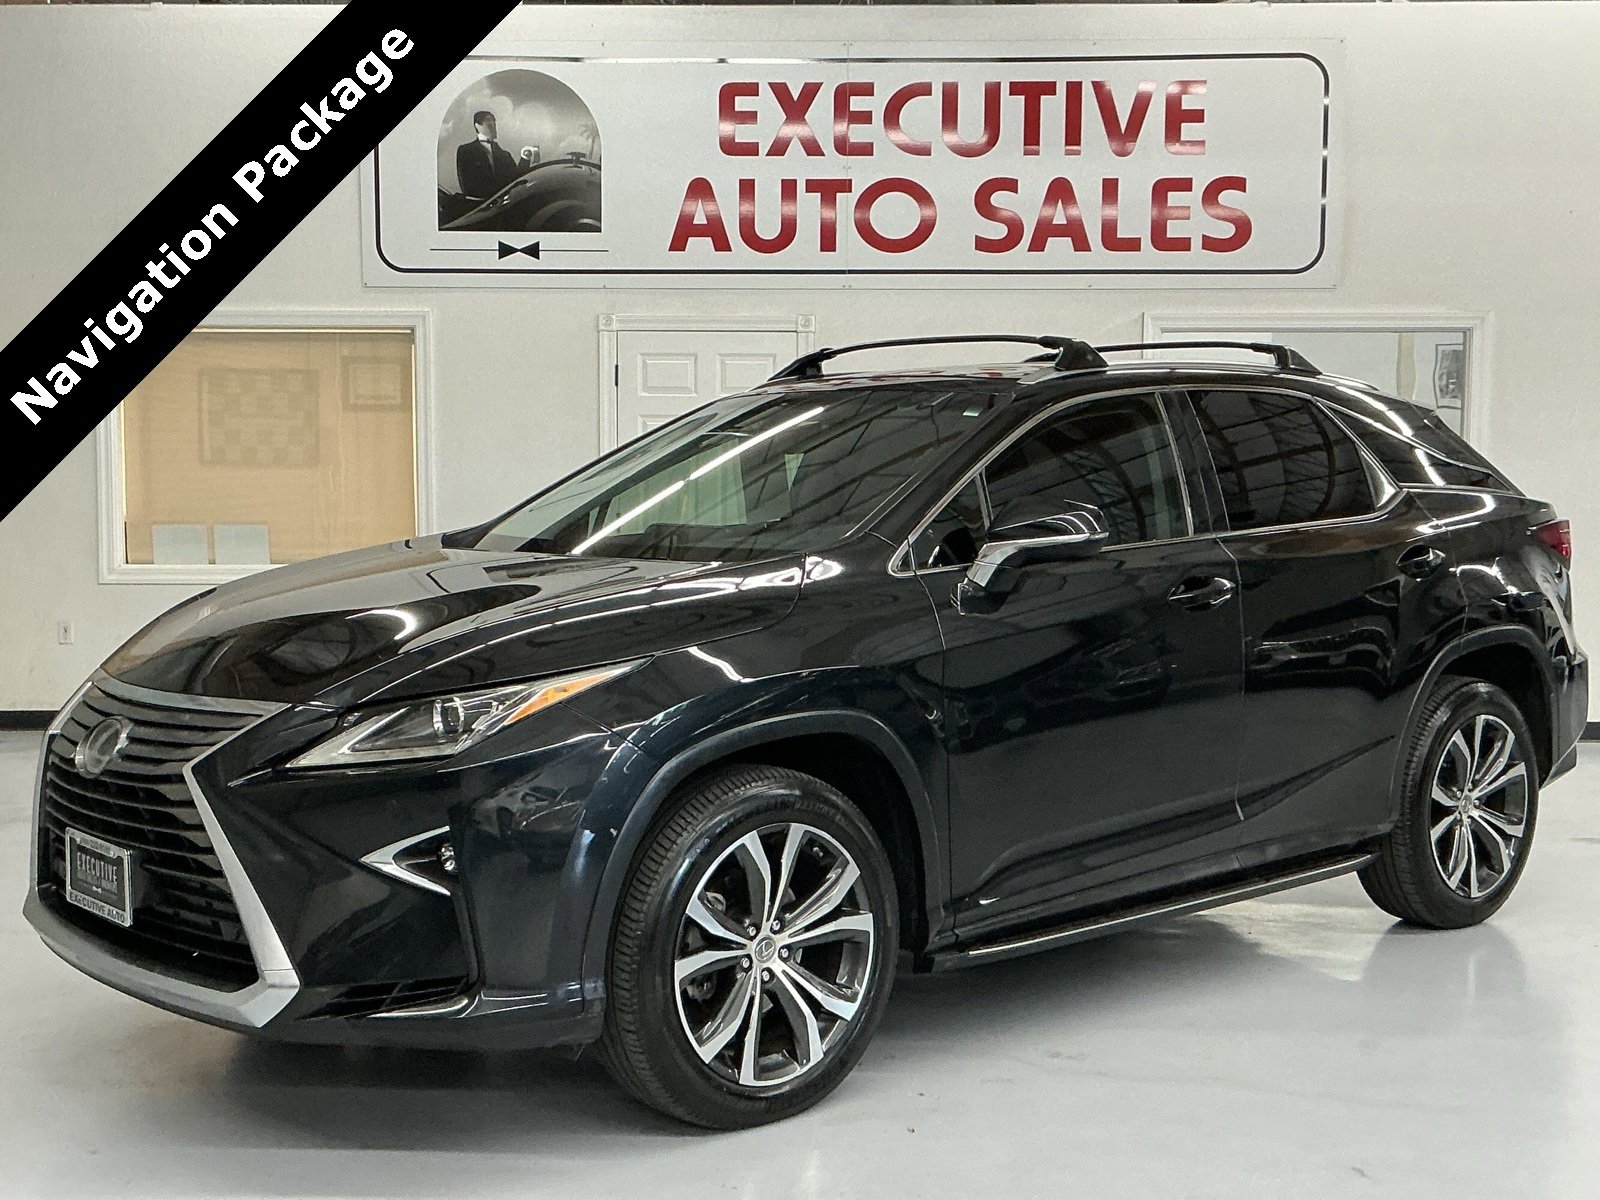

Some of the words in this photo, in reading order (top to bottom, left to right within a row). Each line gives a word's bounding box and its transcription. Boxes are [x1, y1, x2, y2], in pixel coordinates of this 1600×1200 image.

[718, 79, 1208, 158] EXECUTIVE
[668, 177, 937, 255] AUTO
[973, 175, 1253, 254] SALES
[77, 852, 118, 884] EXECUTIVE
[70, 893, 106, 915] EXECUTIVE
[107, 908, 126, 924] AUTO
